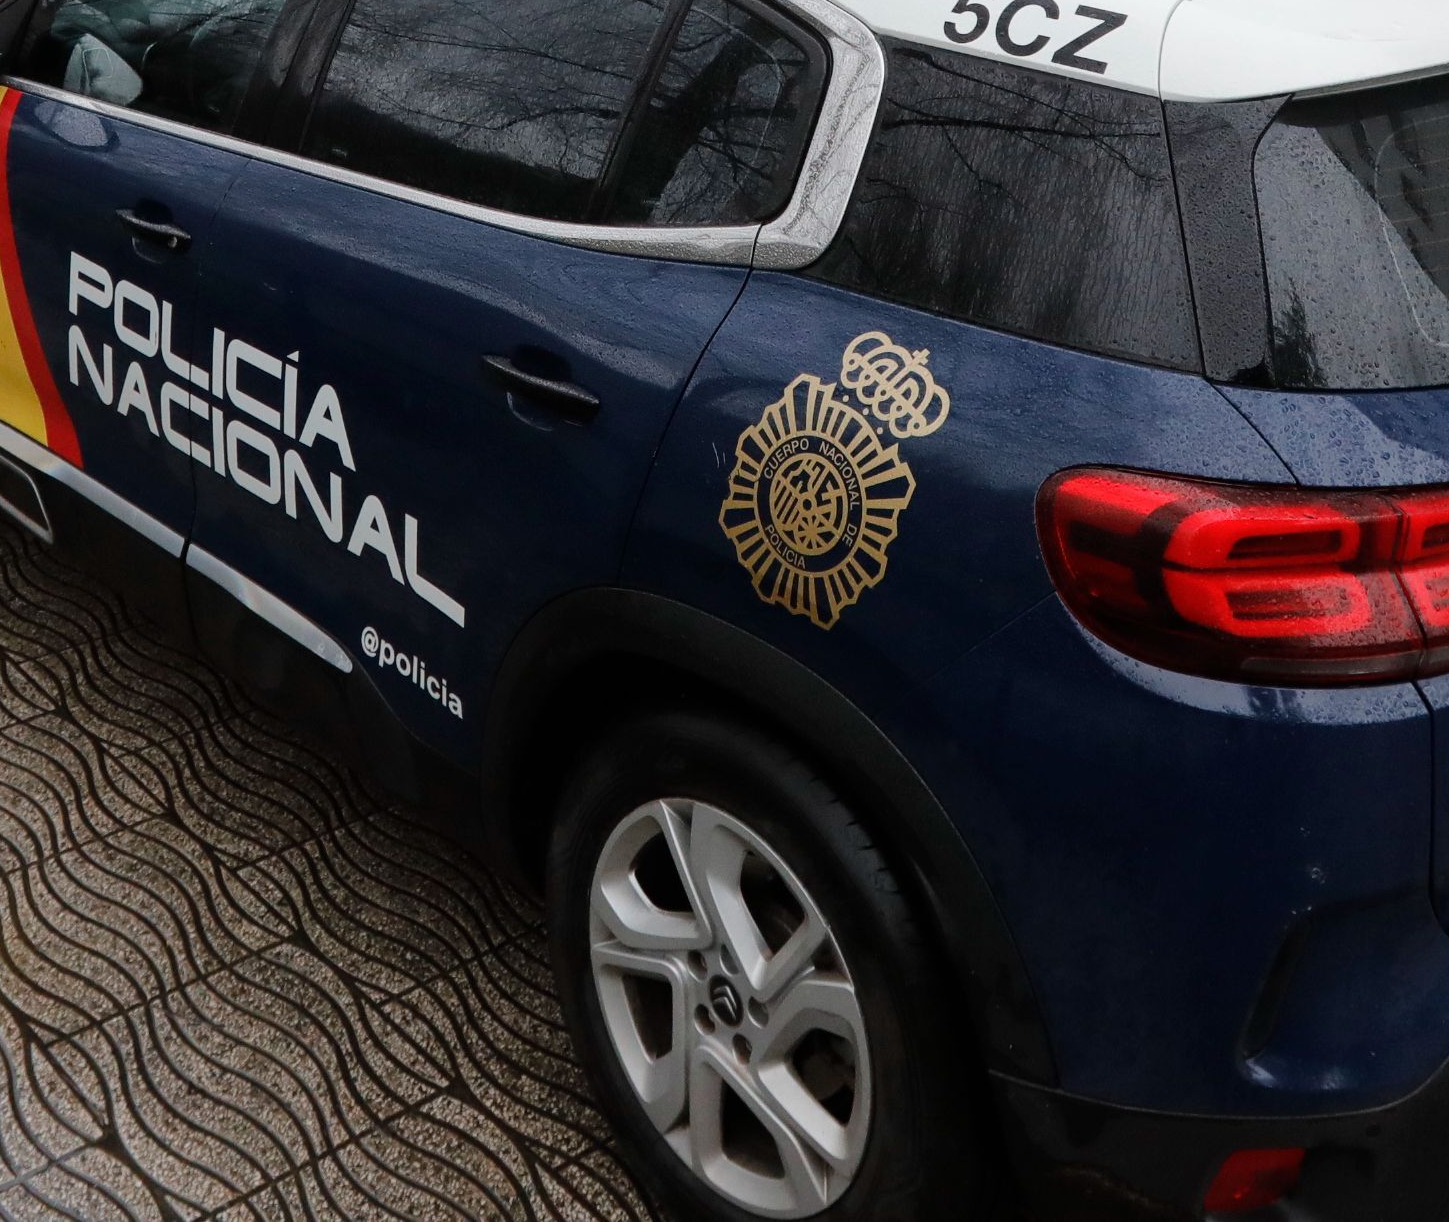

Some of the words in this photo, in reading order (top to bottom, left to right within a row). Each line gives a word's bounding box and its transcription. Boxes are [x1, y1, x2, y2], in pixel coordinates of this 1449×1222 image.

[68, 251, 356, 472] POLICÍA
[68, 324, 465, 628] NACIONAL
[763, 438, 810, 480] CUERPO
[818, 440, 861, 511] NACIONAL
[764, 523, 807, 570] POLICIA
[841, 523, 858, 548] DE
[361, 626, 463, 719] @policia
